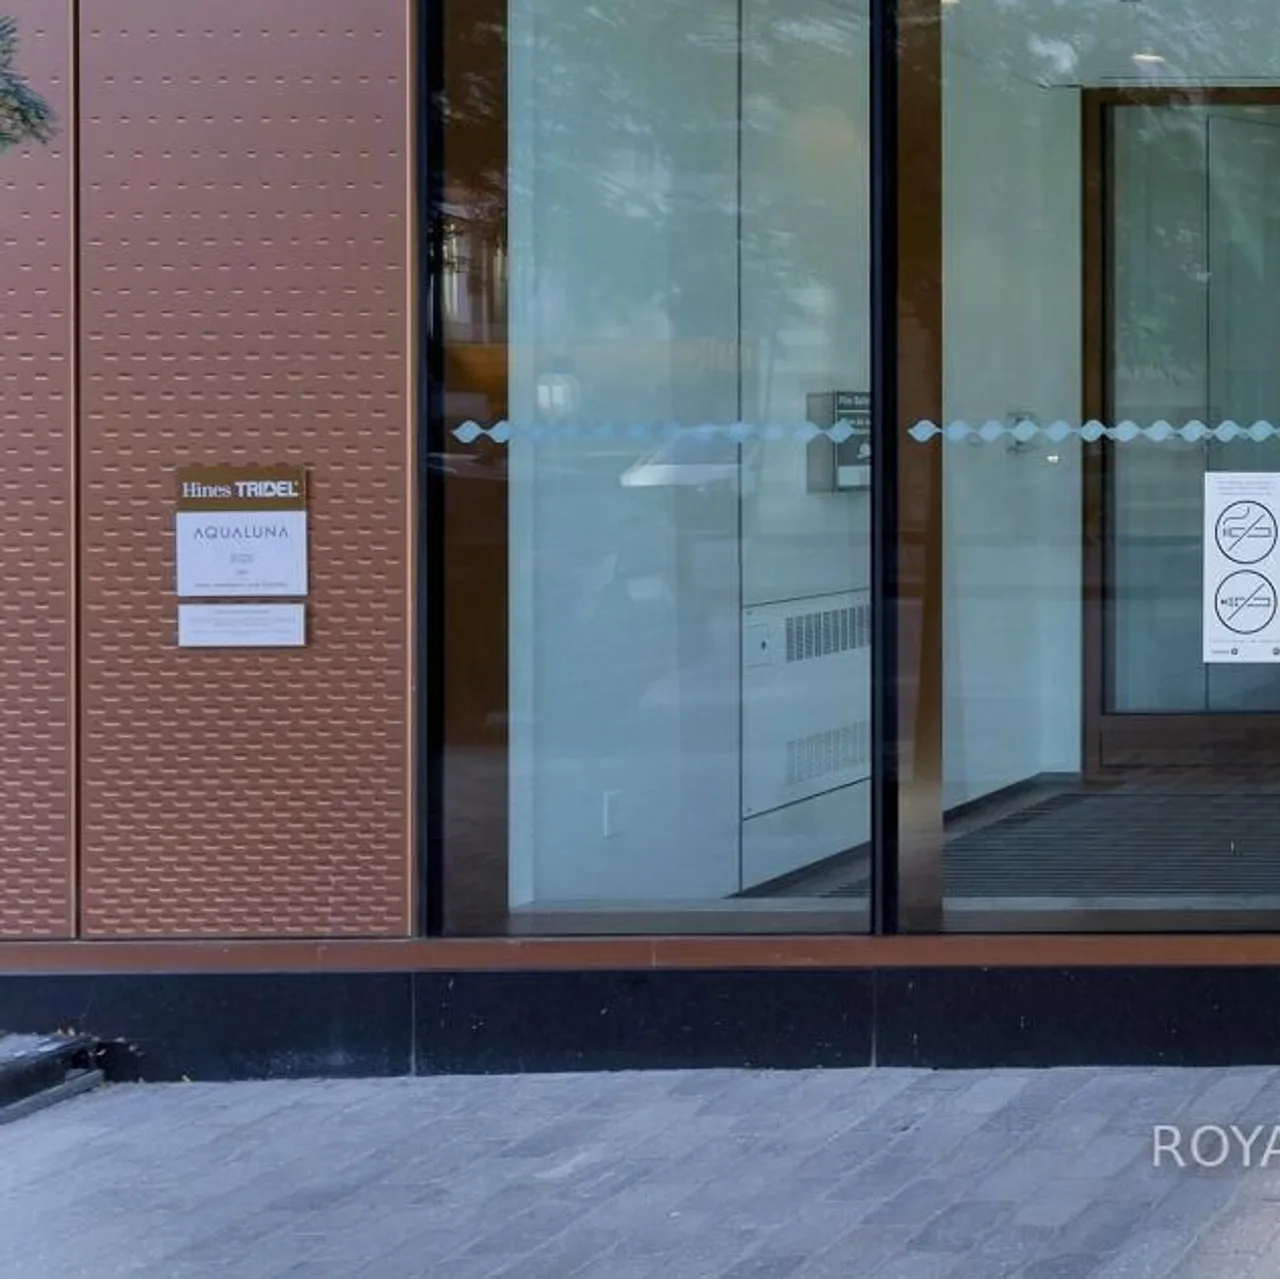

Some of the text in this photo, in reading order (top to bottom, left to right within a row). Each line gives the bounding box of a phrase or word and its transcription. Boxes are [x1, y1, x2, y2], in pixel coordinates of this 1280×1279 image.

[182, 481, 299, 498] Hines TRIDEL
[194, 525, 289, 540] AQUALUNA
